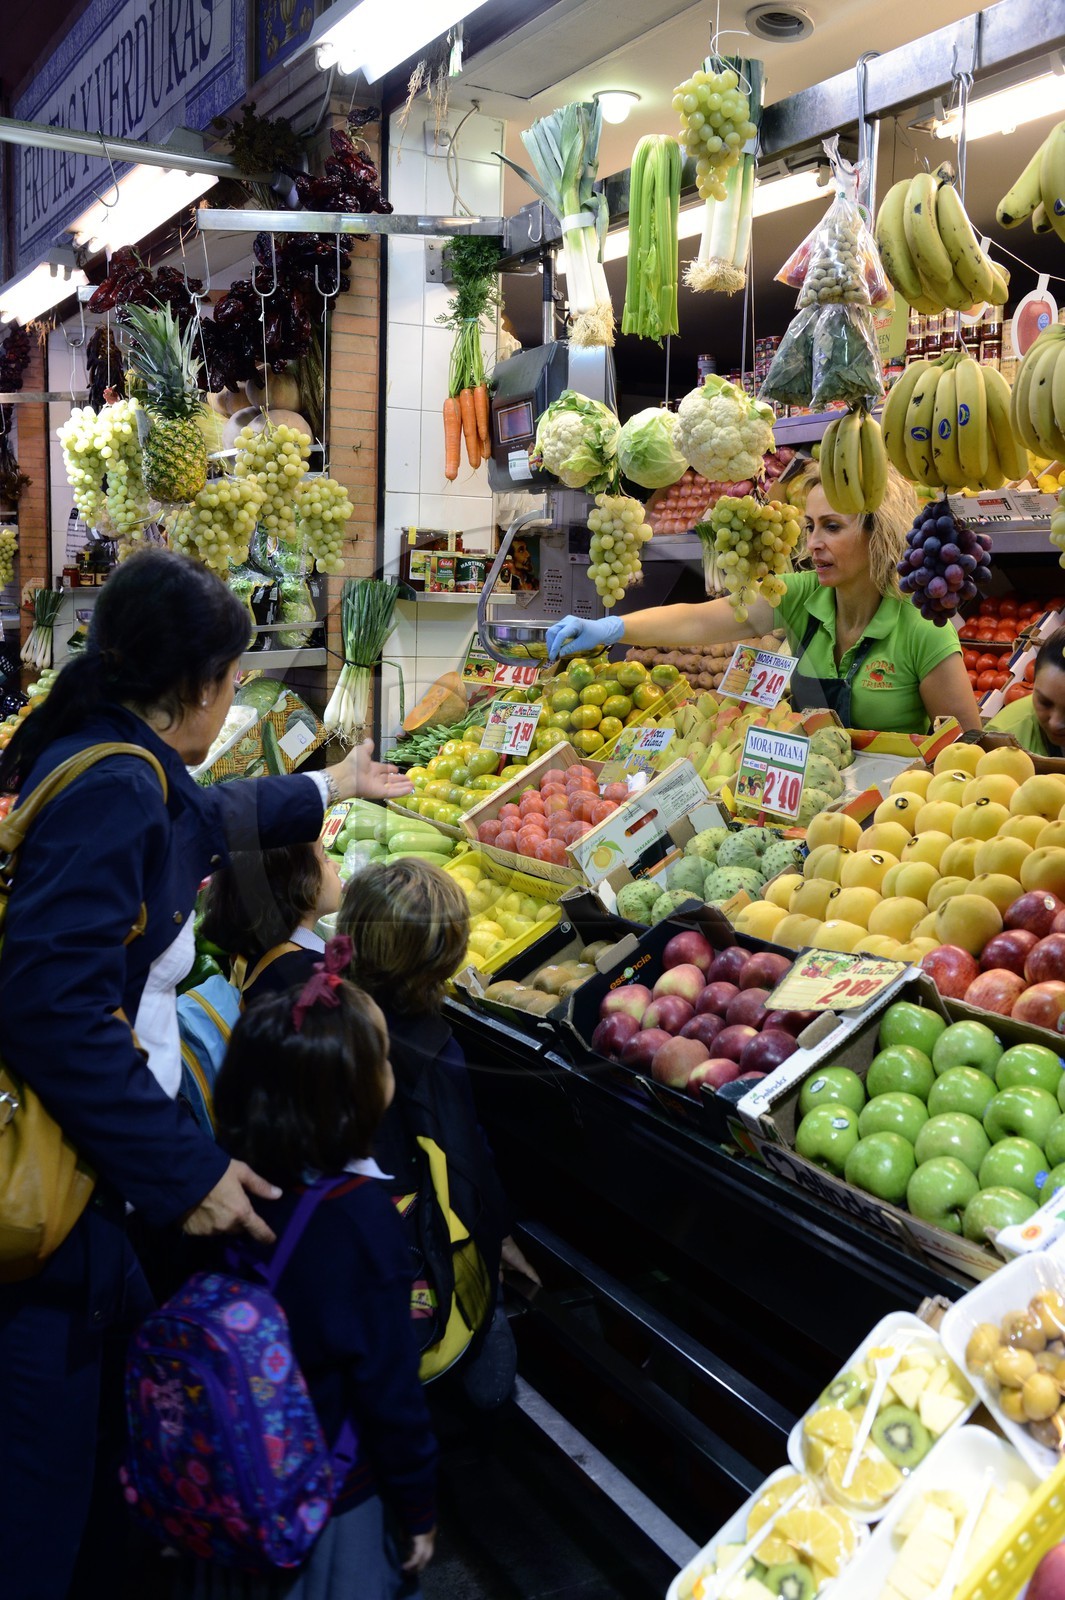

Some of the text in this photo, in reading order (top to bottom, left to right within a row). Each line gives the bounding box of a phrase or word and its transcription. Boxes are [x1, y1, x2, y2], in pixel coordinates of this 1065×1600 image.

[24, 93, 77, 231] FRUTAS
[80, 74, 93, 176] Y
[756, 652, 792, 670] MORA TRIANA
[865, 660, 896, 674] MORA
[750, 669, 785, 698] 2'40
[861, 679, 893, 689] TRIANA
[748, 735, 803, 762] MORA TRIANA
[762, 771, 800, 811] 2'40
[753, 1076, 787, 1104] Melinda
